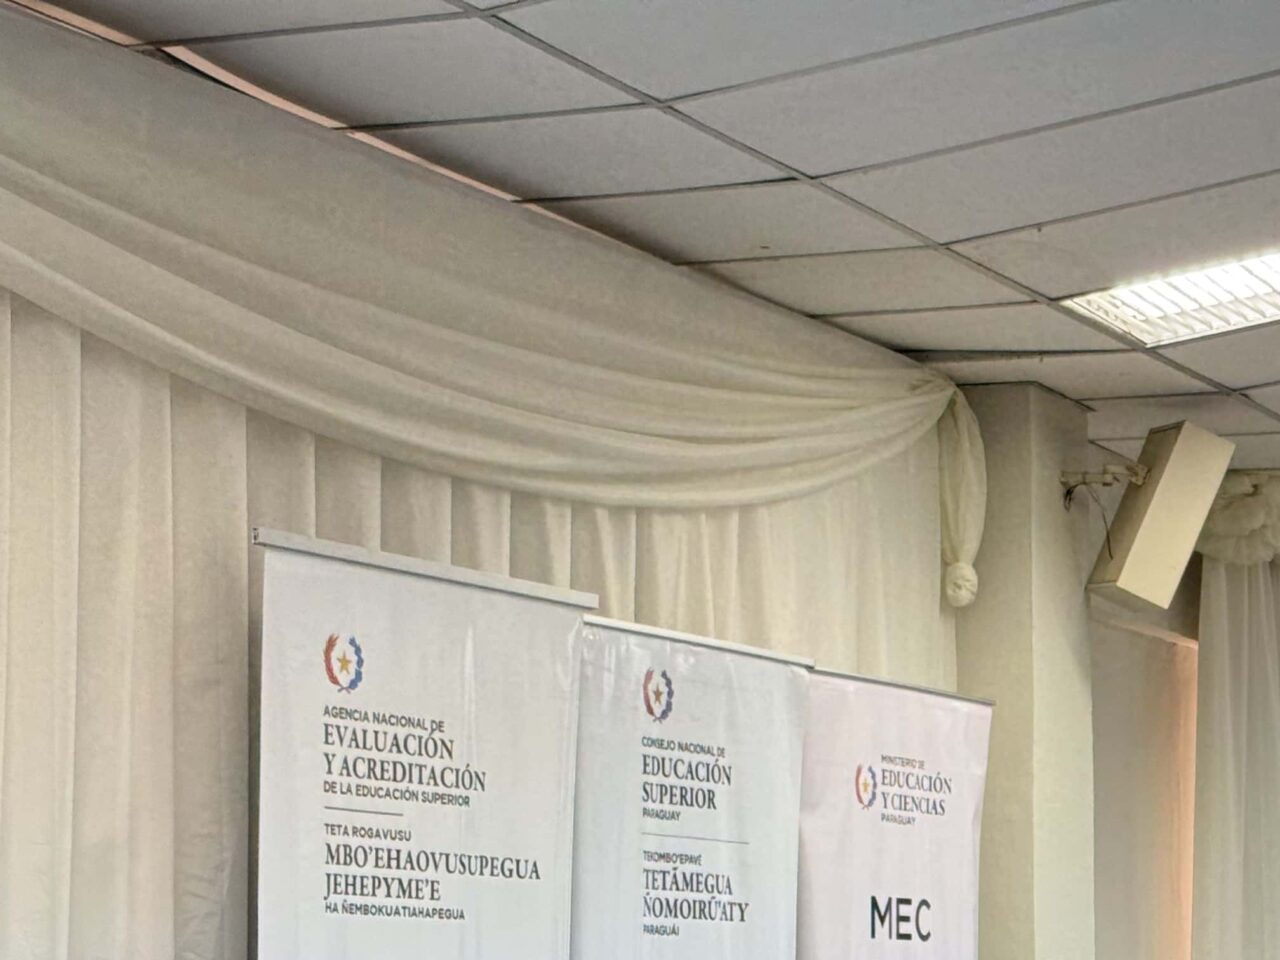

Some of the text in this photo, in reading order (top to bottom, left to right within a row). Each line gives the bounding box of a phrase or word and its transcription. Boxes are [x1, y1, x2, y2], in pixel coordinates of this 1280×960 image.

[323, 705, 445, 733] AGENCIA NACIONAL DE
[323, 723, 455, 761] EVALUACIÓN
[641, 736, 726, 758] CONSEJO NACIONAL DE
[339, 755, 487, 792] ACREDITACIÓN
[642, 753, 732, 786] EDUCACIÓN
[880, 768, 952, 794] EDUCACIÓN
[323, 781, 470, 807] DE LA EDUCACIÓN SUPERIOR
[642, 781, 717, 810] SUPERIOR
[880, 791, 946, 816] Y CIENCIAS
[642, 807, 681, 821] PARAGUAY
[325, 901, 339, 914] HA
[869, 894, 932, 943] MEC
